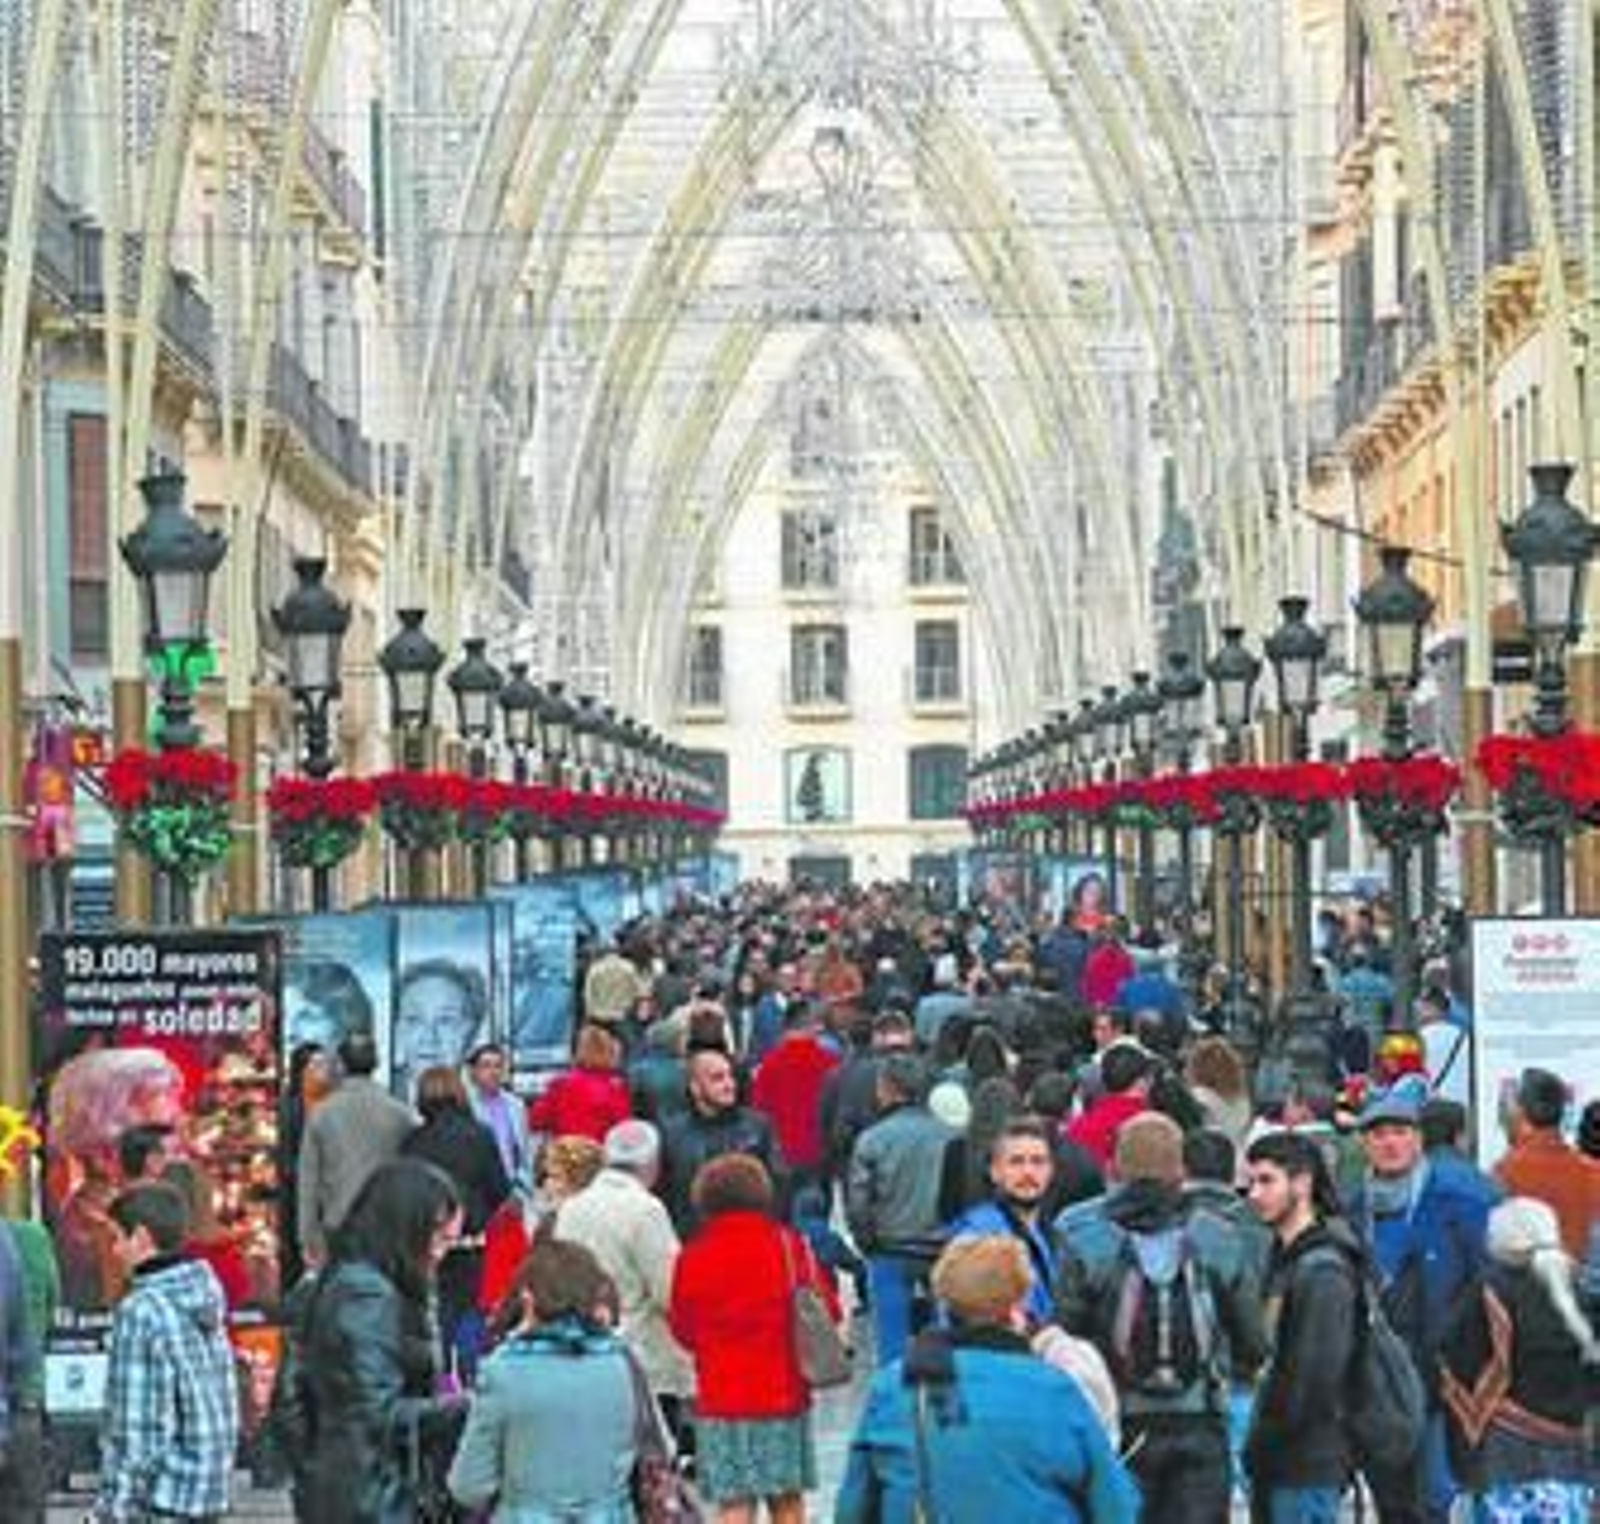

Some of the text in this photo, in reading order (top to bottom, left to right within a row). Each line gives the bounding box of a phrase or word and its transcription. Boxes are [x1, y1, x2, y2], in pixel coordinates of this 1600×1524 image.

[64, 945, 258, 978] 19.000 mayores
[144, 1001, 261, 1035] soledad
